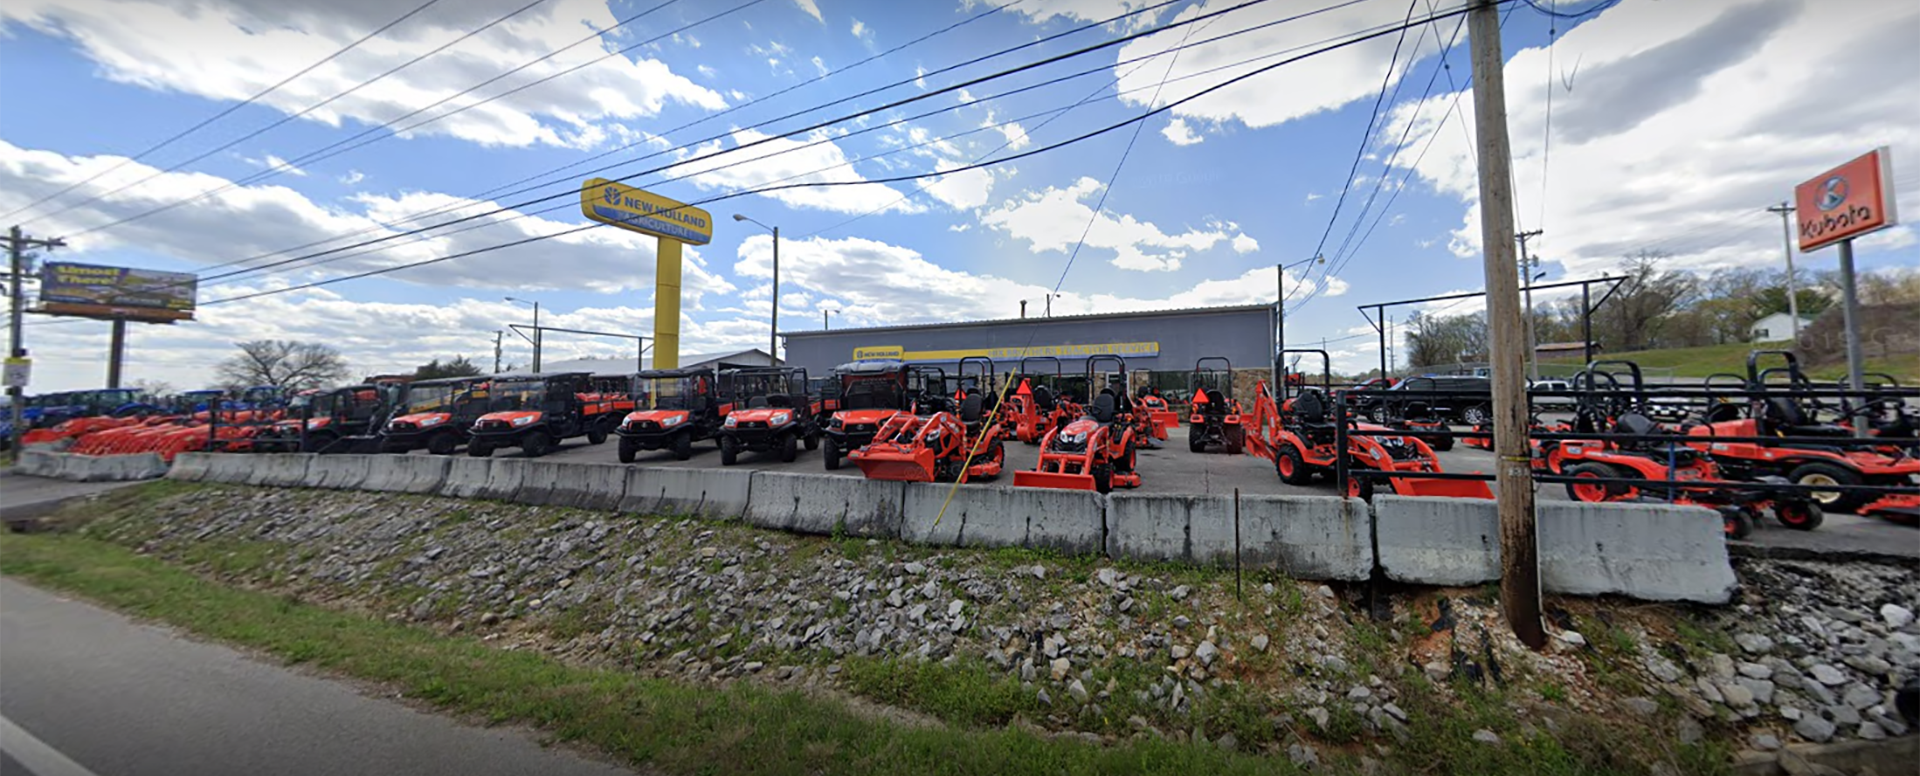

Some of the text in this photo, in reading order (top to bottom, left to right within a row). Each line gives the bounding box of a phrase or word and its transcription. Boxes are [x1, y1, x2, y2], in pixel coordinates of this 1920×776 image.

[623, 213, 690, 237] AGRICULTURE
[624, 196, 706, 228] NEW HOLLAND
[1801, 205, 1871, 239] Kubota
